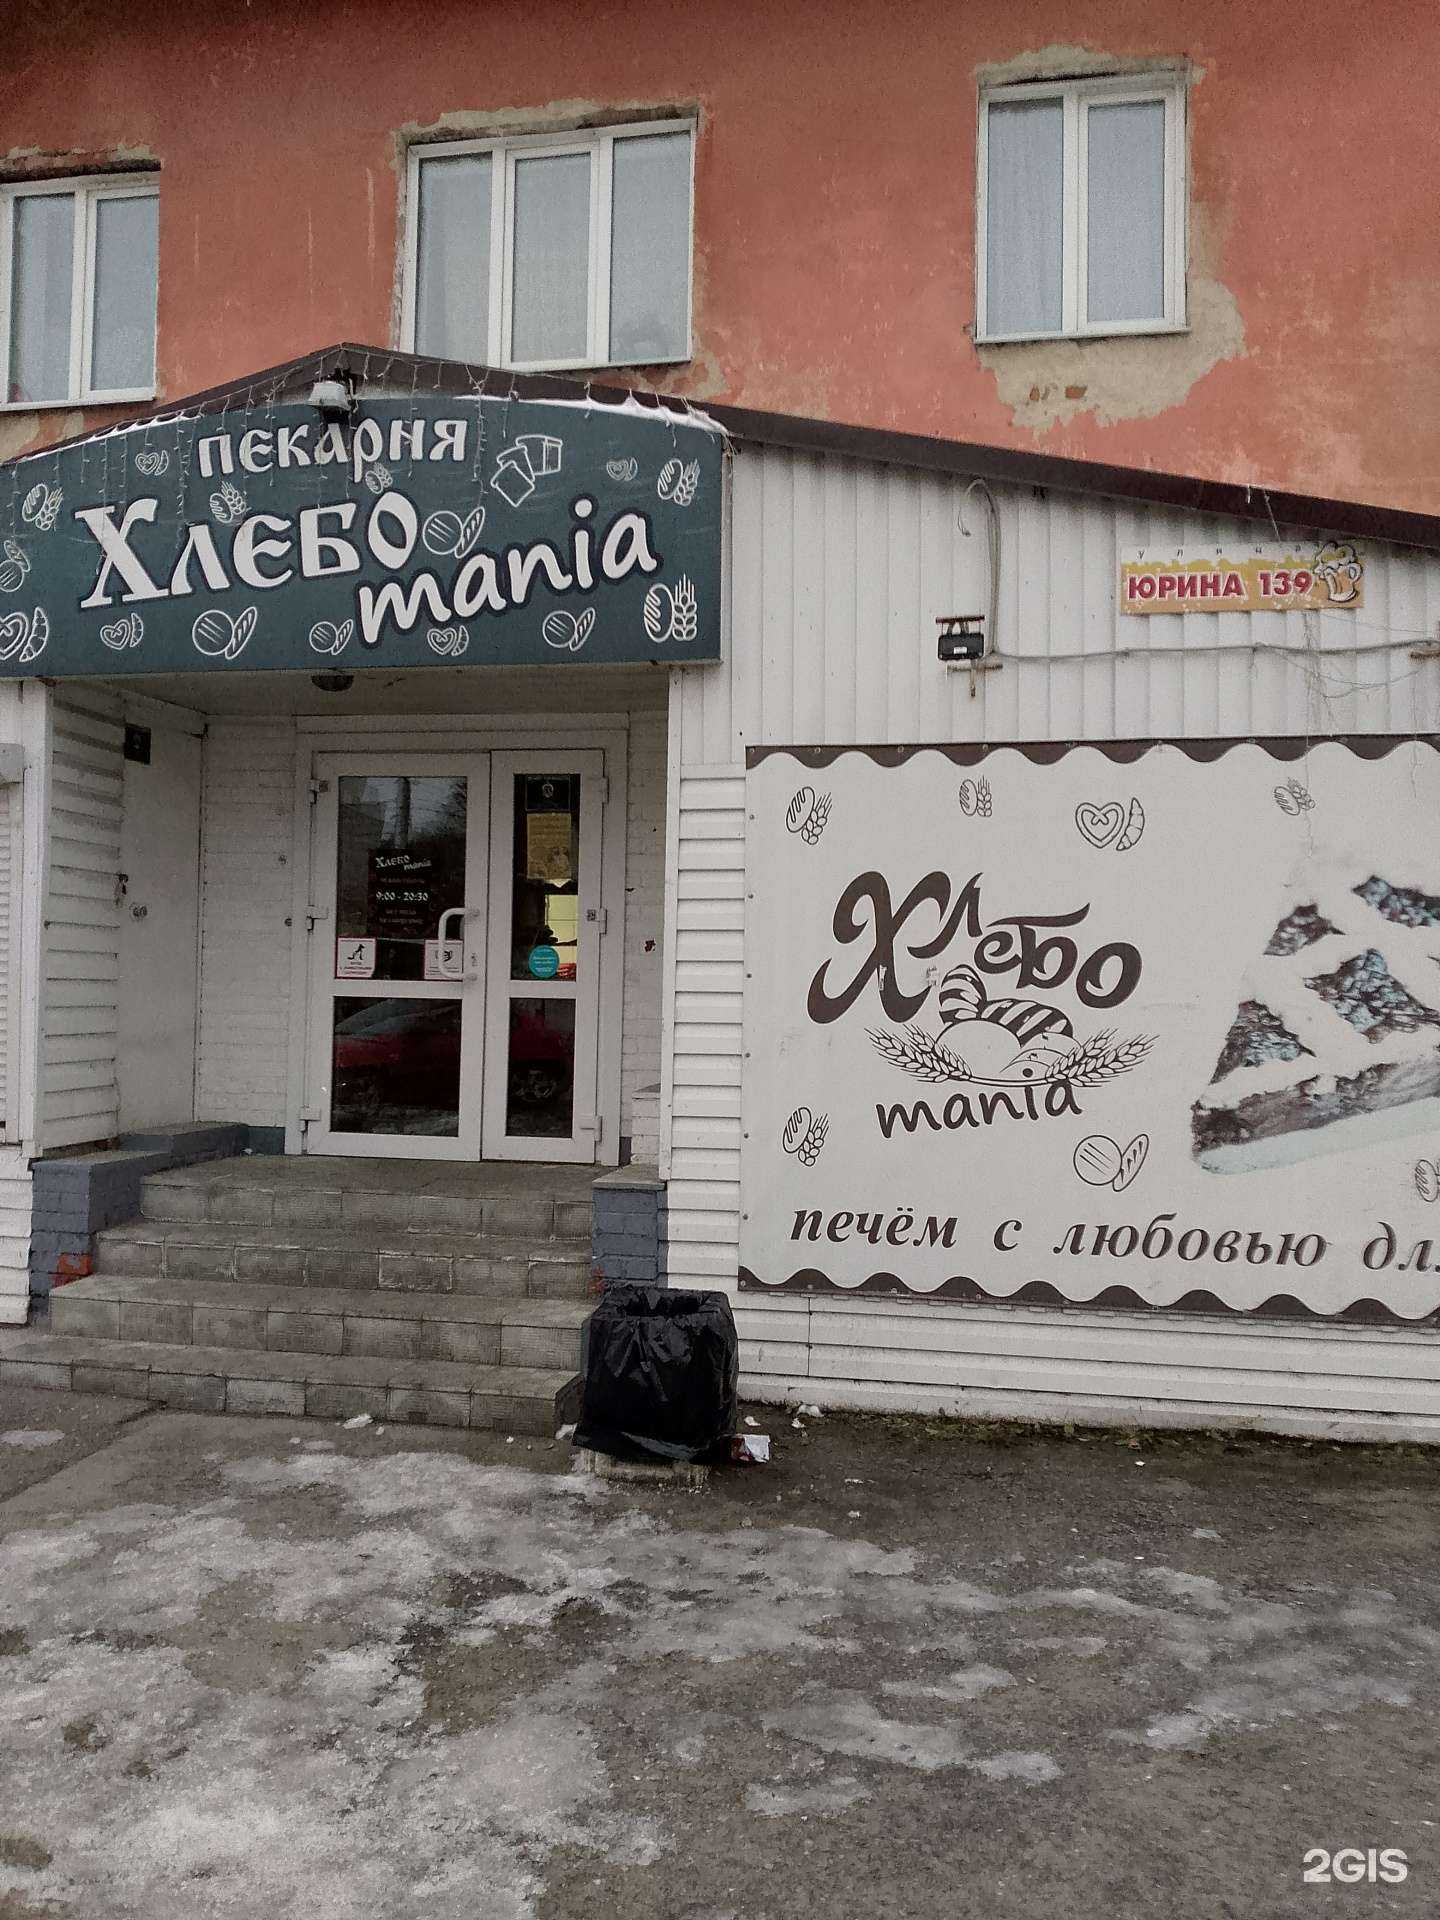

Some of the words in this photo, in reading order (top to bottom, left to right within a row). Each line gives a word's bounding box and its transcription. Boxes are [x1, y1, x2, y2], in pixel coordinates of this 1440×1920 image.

[359, 499, 658, 643] mania
[1128, 572, 1246, 600] ЮРИНА
[1259, 570, 1313, 597] 139
[376, 891, 396, 901] 9:00
[403, 892, 429, 901] 20:30
[874, 1068, 1083, 1138] mania
[790, 1206, 958, 1249] печём
[993, 1219, 1023, 1251] с
[1053, 1213, 1327, 1267] любовью
[1363, 1221, 1440, 1273] дл
